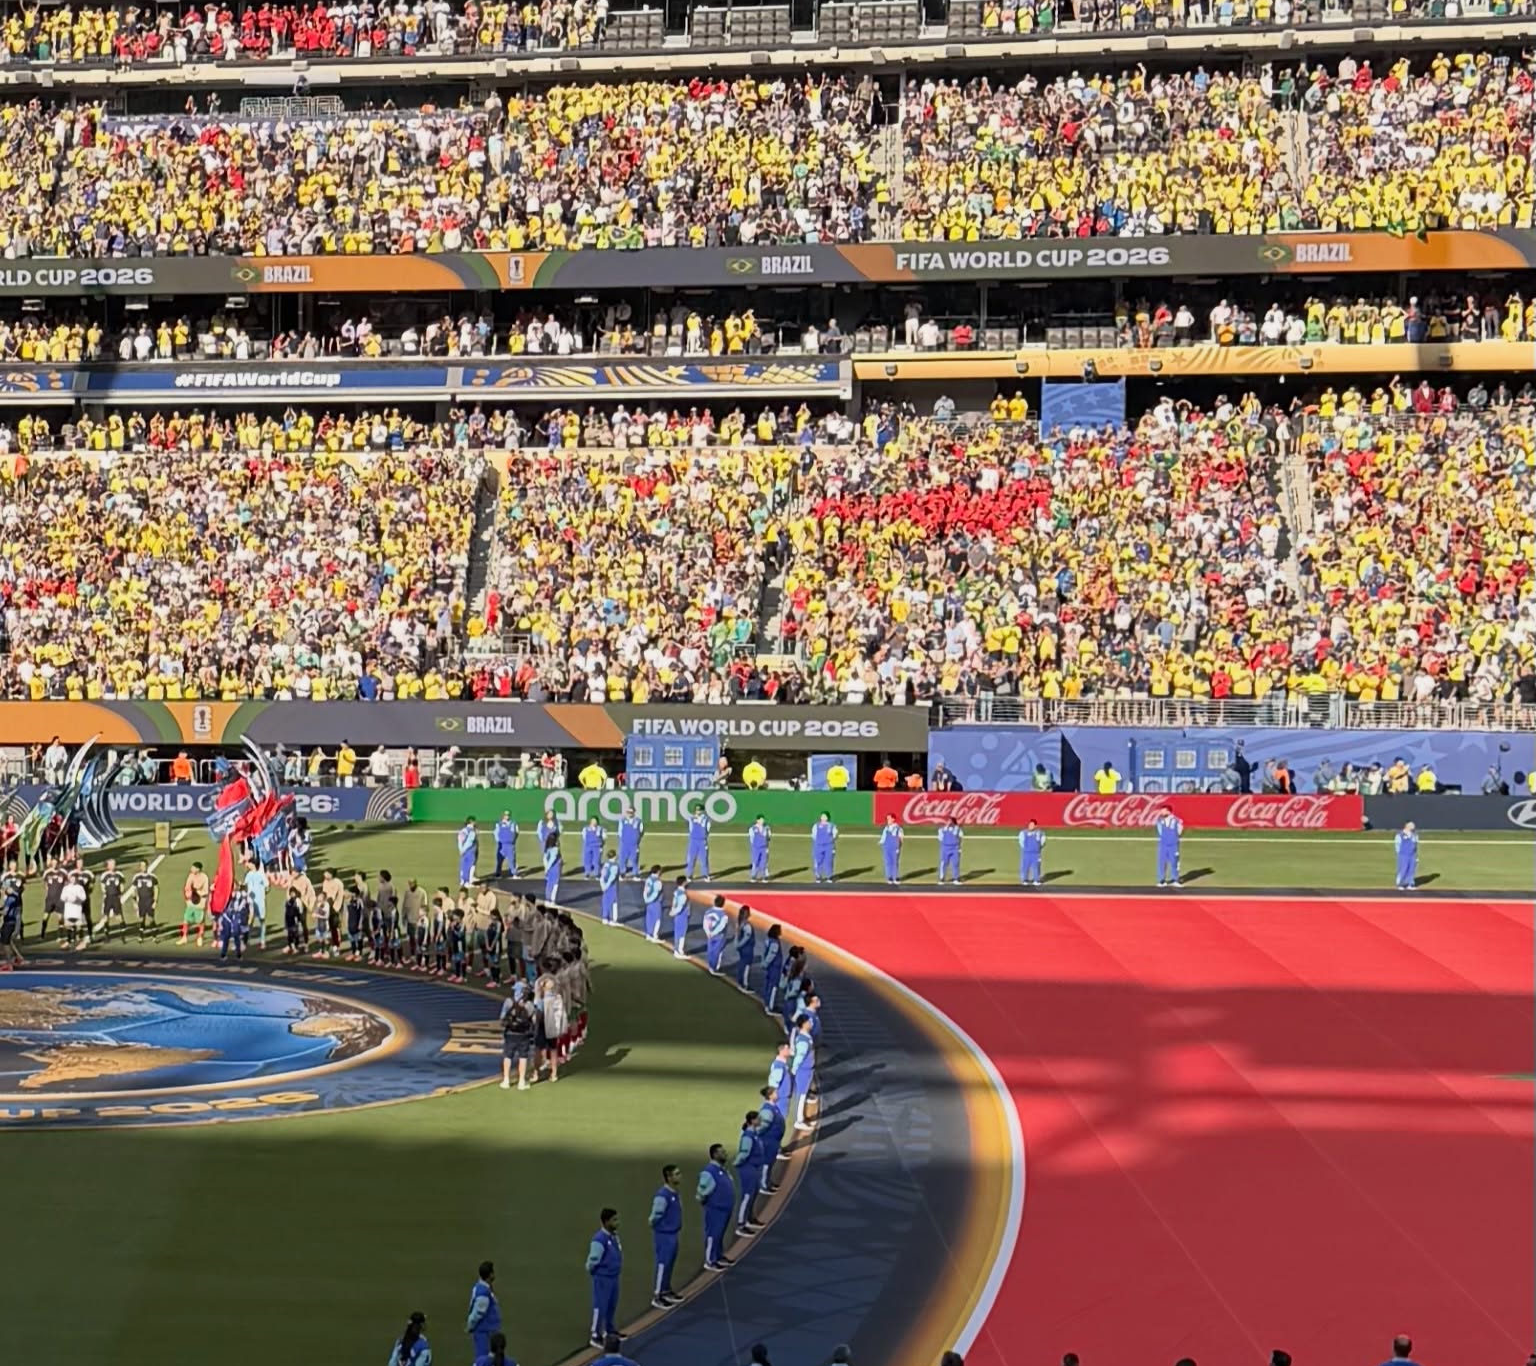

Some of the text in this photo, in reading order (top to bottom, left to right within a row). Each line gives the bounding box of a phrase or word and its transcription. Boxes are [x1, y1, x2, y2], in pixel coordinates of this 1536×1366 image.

[896, 247, 1170, 271] FIFA WORLD CUP 2026
[1295, 243, 1353, 263] BRAZIL
[263, 264, 314, 284] BRAZIL
[761, 255, 814, 275] BRAZIL
[36, 269, 77, 287] CUP
[80, 268, 153, 286] 2026
[174, 369, 342, 389] #FIFAWorldCup
[466, 716, 515, 734] BRAZIL
[632, 719, 879, 737] FIFA WORLD CUP 2026
[109, 792, 194, 812] WORLD
[544, 790, 737, 823] aramco
[95, 1091, 320, 1117] 2026
